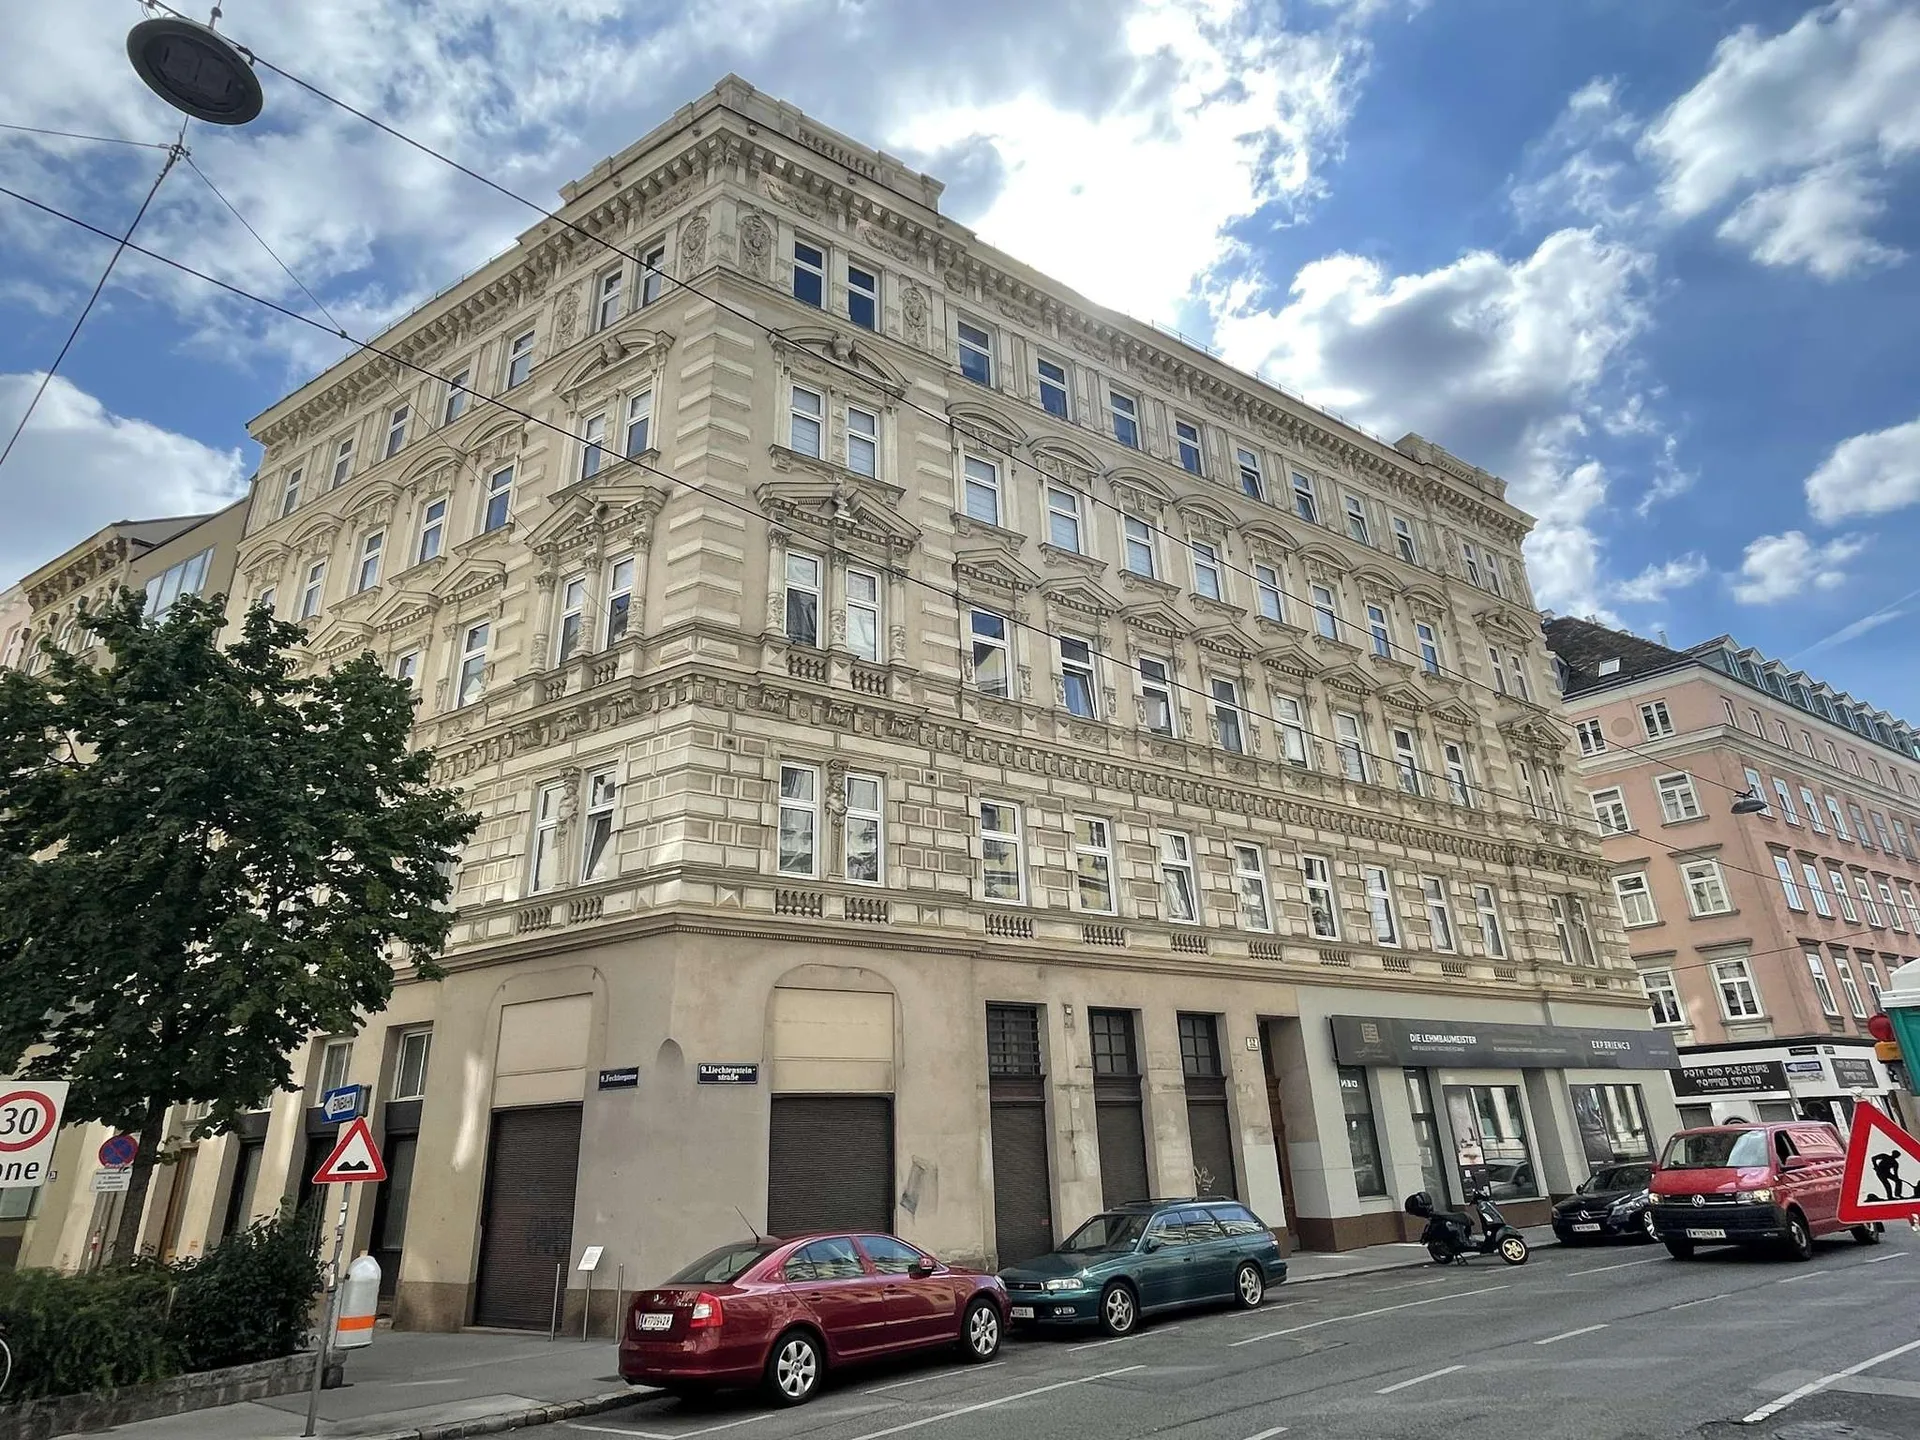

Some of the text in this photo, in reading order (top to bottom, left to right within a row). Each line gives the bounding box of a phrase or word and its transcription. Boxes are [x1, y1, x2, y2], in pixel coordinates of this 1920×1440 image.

[1409, 1033, 1477, 1044] DIE LEHMBAUMEISTER
[0, 1107, 39, 1135] 30
